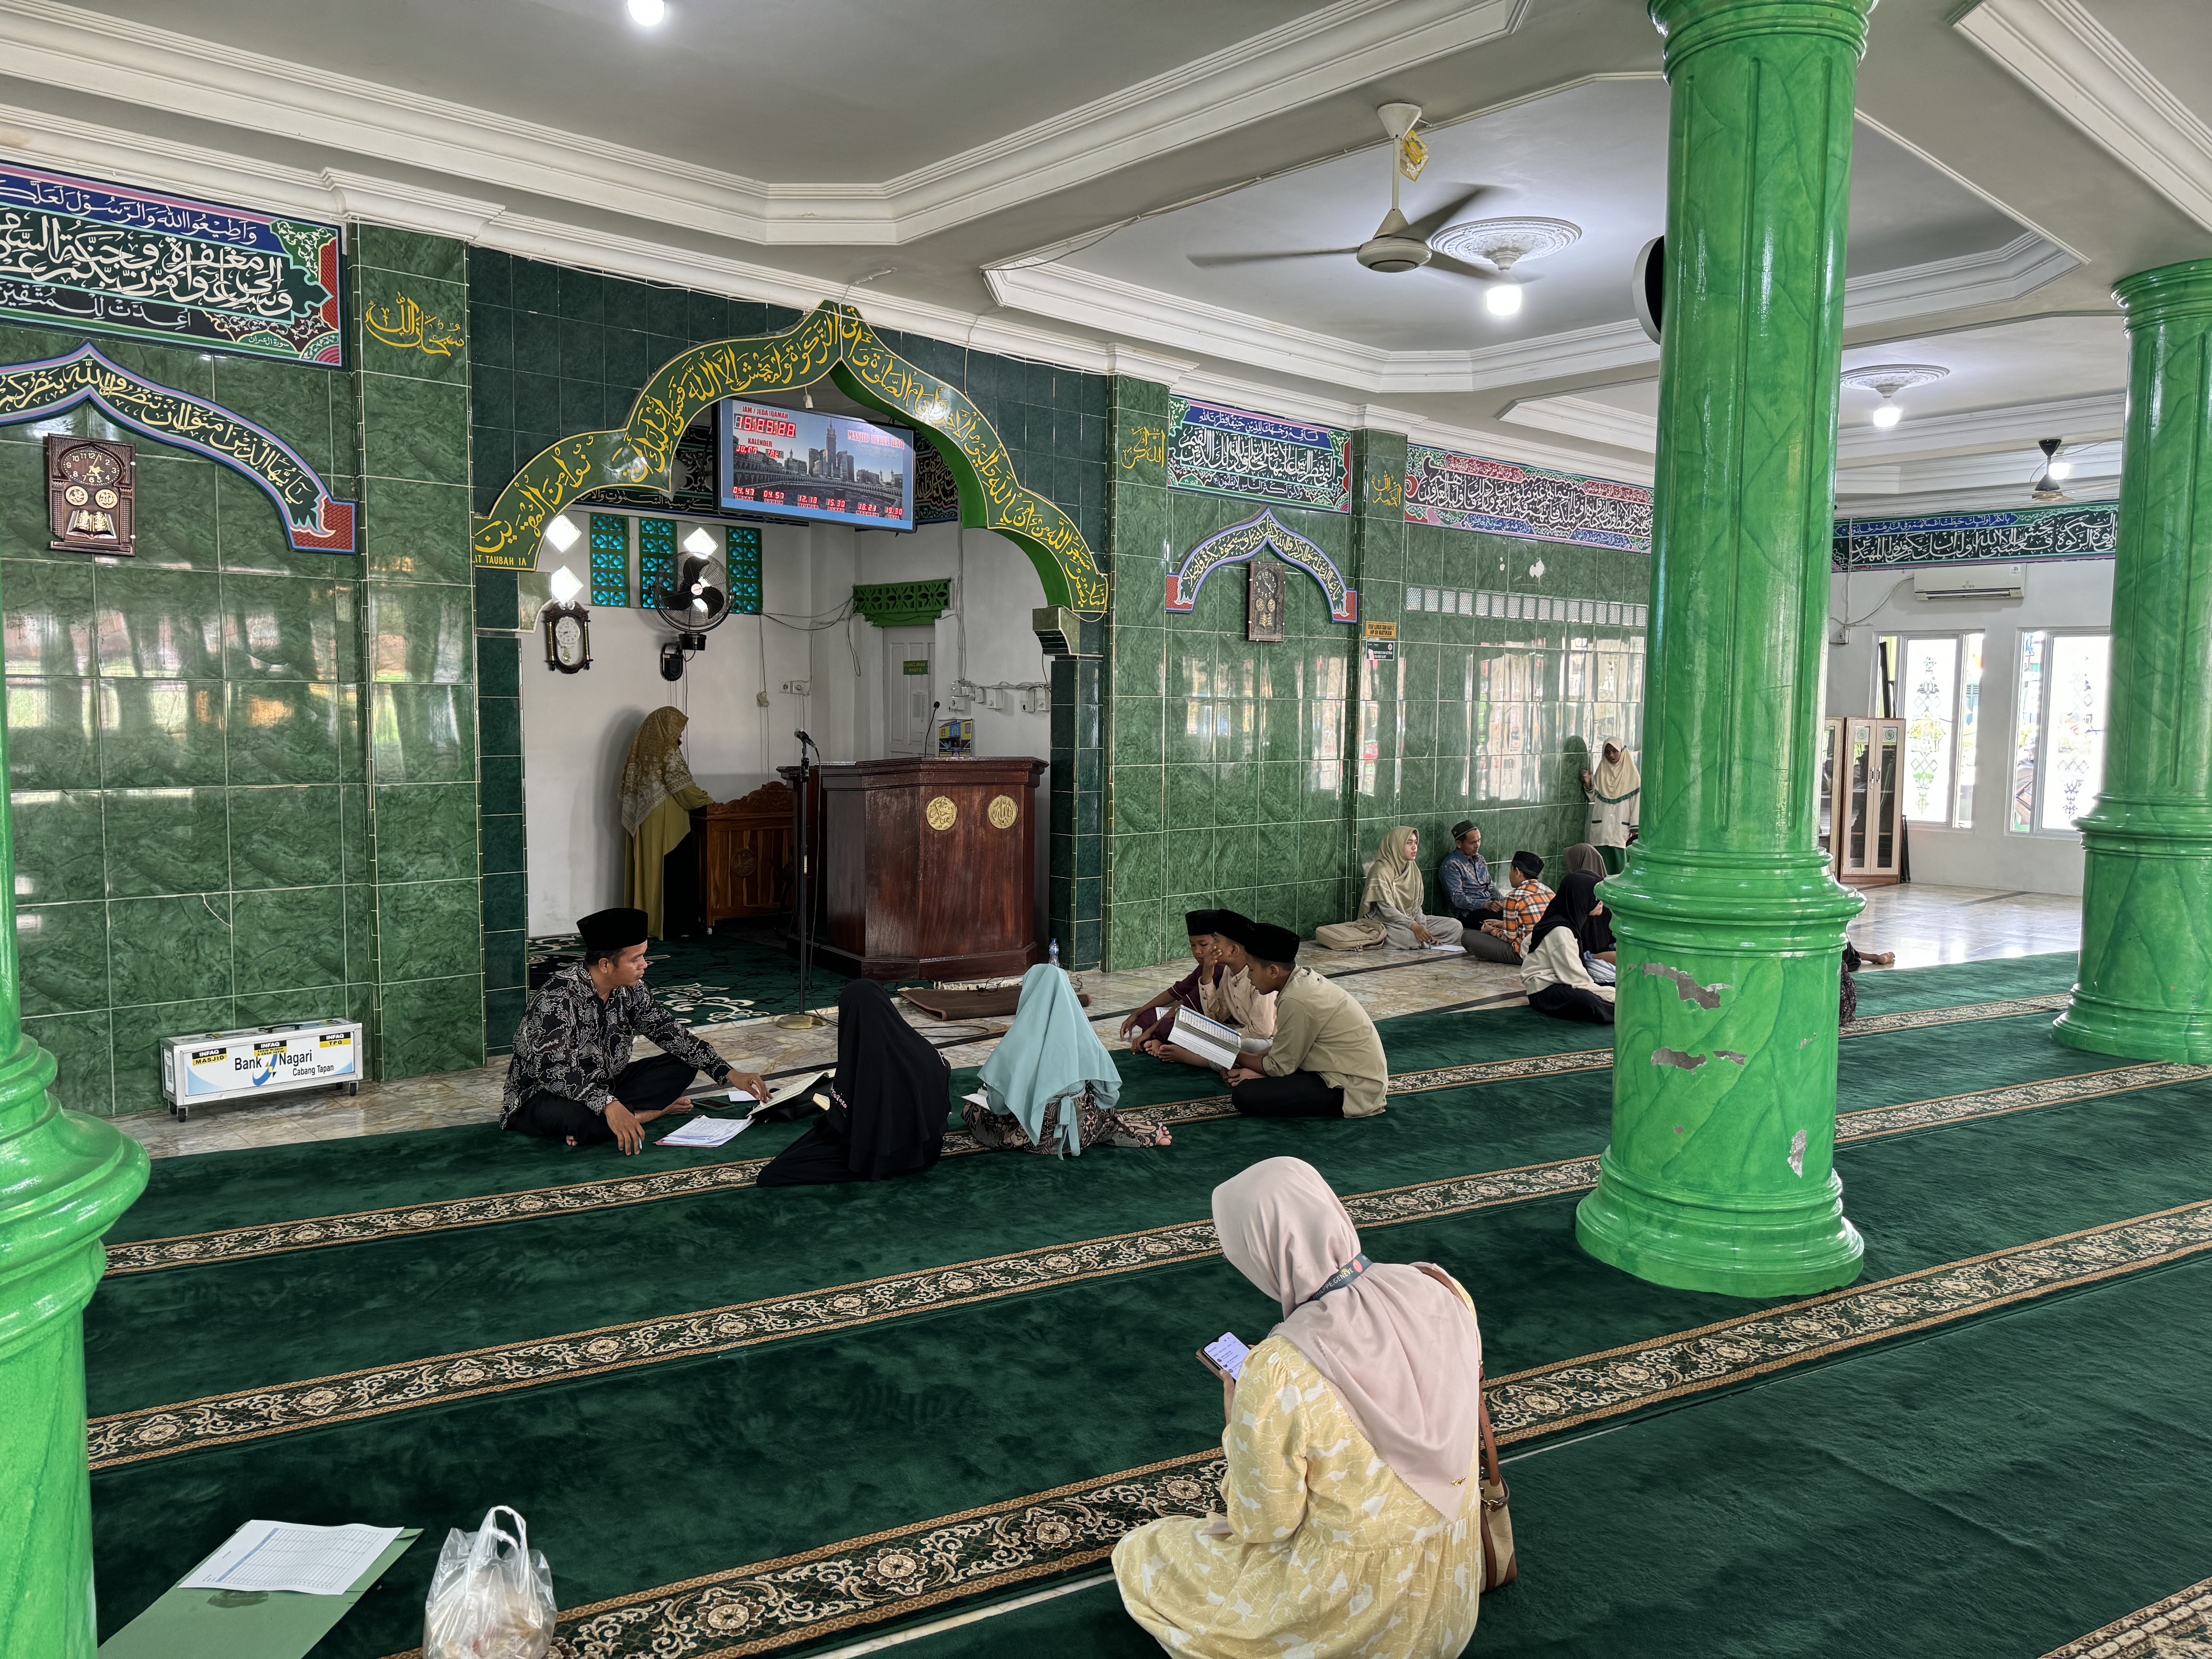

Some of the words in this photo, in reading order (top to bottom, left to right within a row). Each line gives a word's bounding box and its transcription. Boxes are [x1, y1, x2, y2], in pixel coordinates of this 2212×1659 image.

[769, 410, 788, 419] IQAMAH
[748, 437, 773, 447] KALENDER
[848, 430, 870, 443] MASJID
[891, 438, 905, 450] HAQ
[485, 555, 514, 566] TAUBAH
[199, 1049, 220, 1057] INFAQ
[195, 1055, 225, 1065] MASJID
[235, 1056, 262, 1071] Bank
[279, 1049, 312, 1067] Nagari
[293, 1066, 316, 1076] Cabang
[317, 1065, 334, 1074] Tapan
